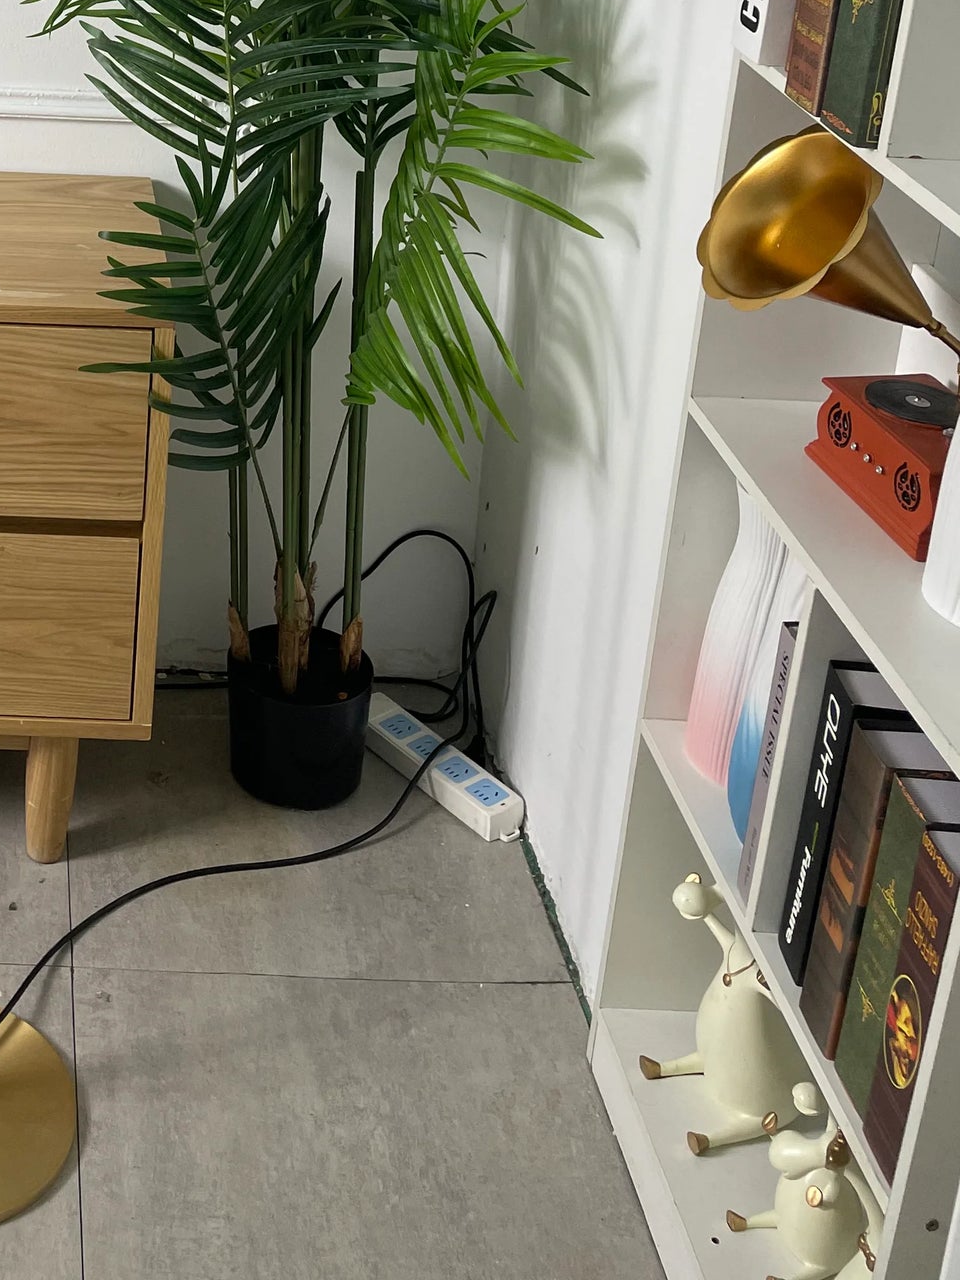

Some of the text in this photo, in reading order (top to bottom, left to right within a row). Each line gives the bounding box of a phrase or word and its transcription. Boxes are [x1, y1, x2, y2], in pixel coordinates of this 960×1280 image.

[760, 650, 790, 784] SPECIAL ISSUE
[785, 845, 812, 945] Furniture
